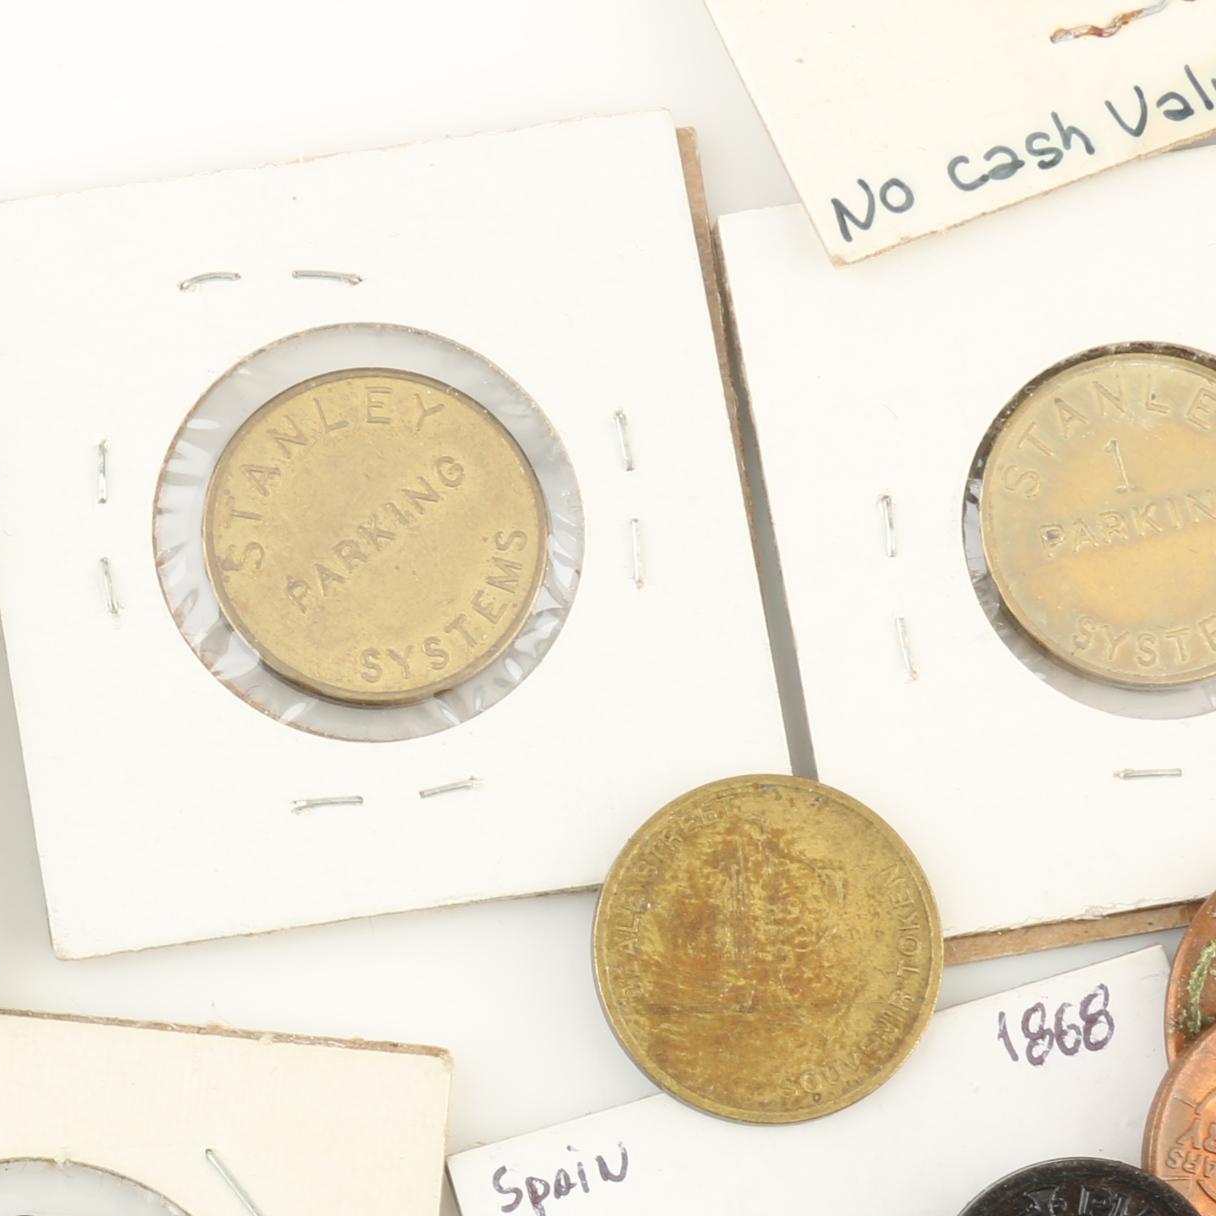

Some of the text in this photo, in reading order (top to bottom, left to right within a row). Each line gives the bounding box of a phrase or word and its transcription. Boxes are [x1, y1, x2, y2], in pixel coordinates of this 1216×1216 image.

[831, 63, 1216, 243] No cash Val
[220, 384, 446, 574] STANLEY
[285, 454, 466, 614] PARKING
[360, 528, 529, 684] SYSTEMS
[881, 862, 923, 977] TOKEN
[997, 982, 1116, 1067] 1868
